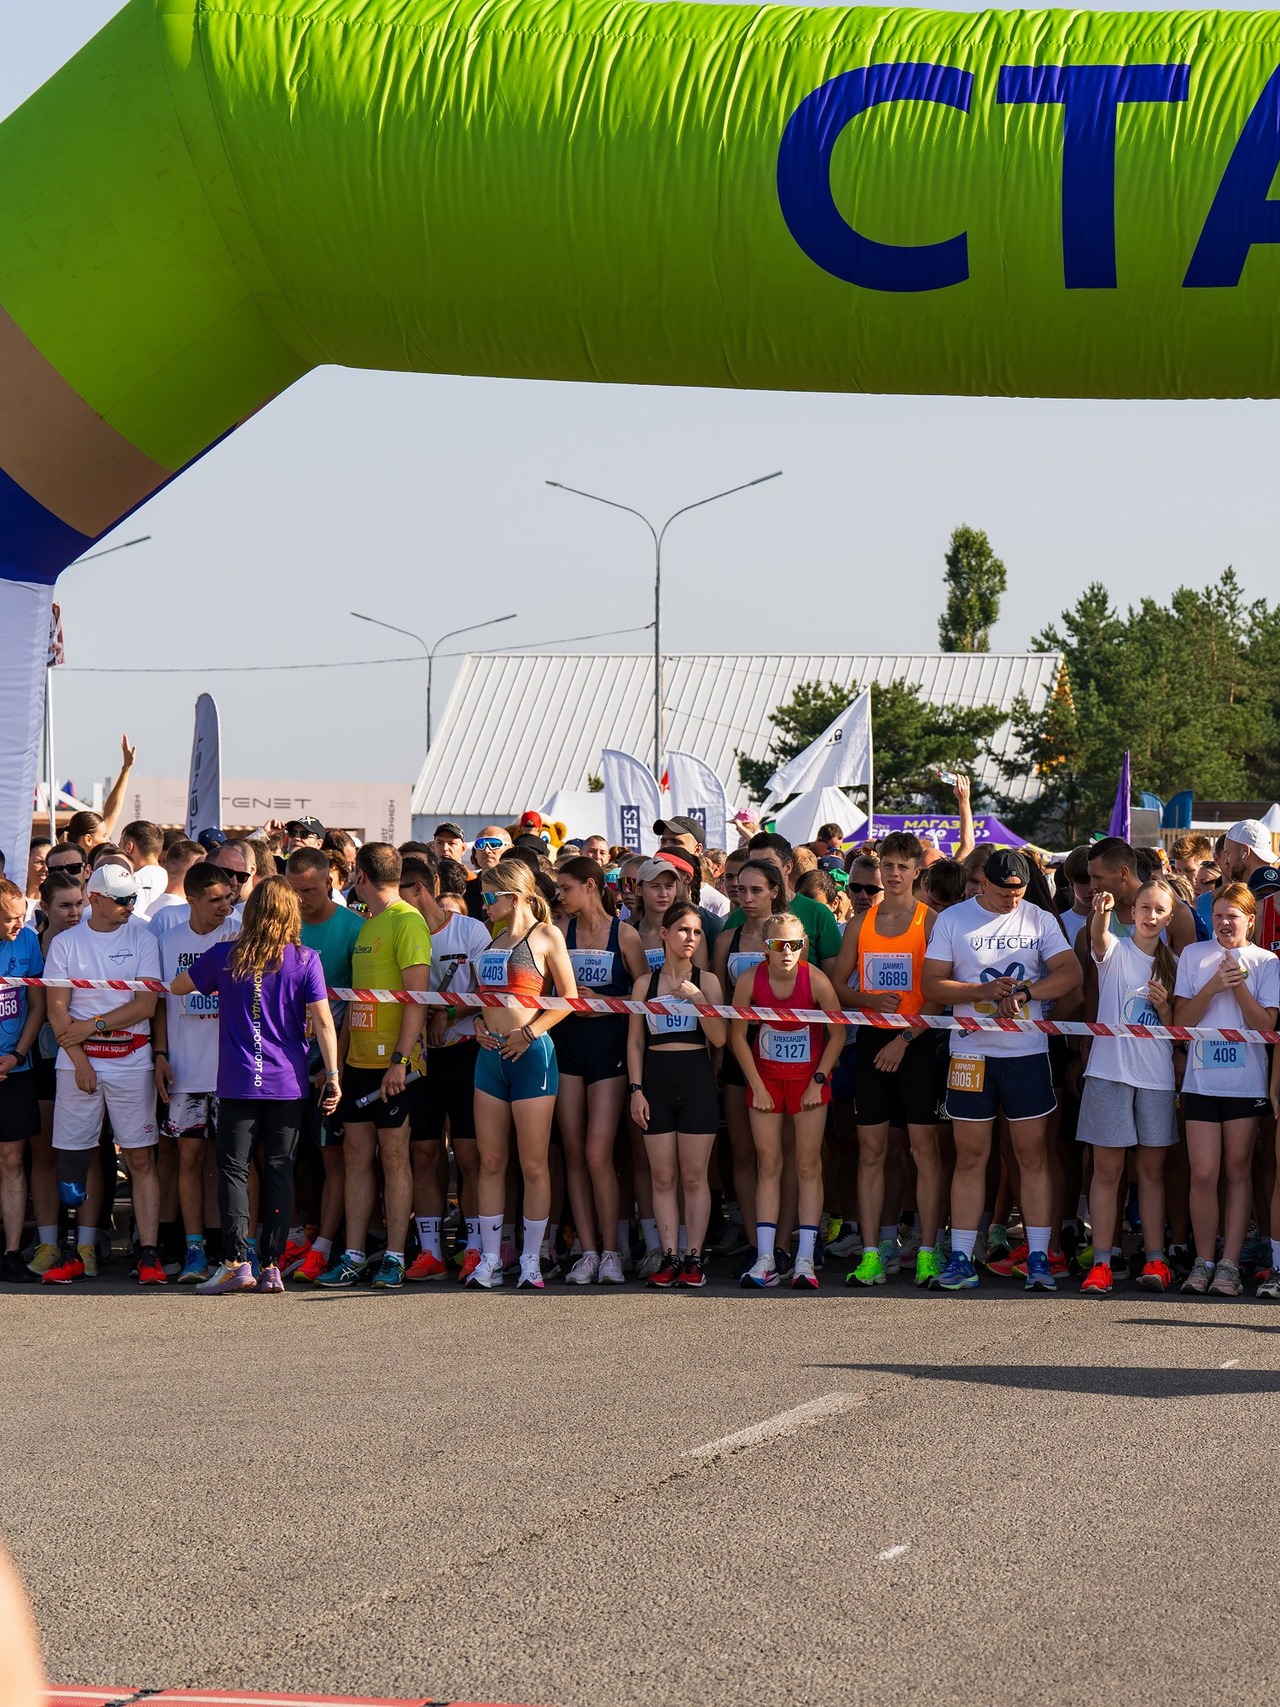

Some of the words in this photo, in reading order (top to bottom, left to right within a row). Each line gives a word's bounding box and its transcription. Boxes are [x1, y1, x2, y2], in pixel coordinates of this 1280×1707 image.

[623, 809, 638, 848] EFES
[903, 819, 985, 830] МАГАЗН
[584, 958, 602, 966] СОФЬЯ
[882, 962, 904, 970] ДАНИИЛ
[481, 965, 504, 981] 4403
[578, 966, 607, 983] 2842
[878, 970, 908, 987] 3689
[189, 994, 220, 1010] 4065
[665, 1014, 689, 1028] 697
[773, 1035, 807, 1043] АЛЕКСАНДРА
[253, 1021, 264, 1073] ПРОСПОРТ
[775, 1044, 806, 1059] 2127
[1213, 1047, 1237, 1064] 408
[954, 1063, 976, 1071] КИРИЛЛ
[253, 1074, 264, 1087] 40
[951, 1071, 981, 1089] 6005.1
